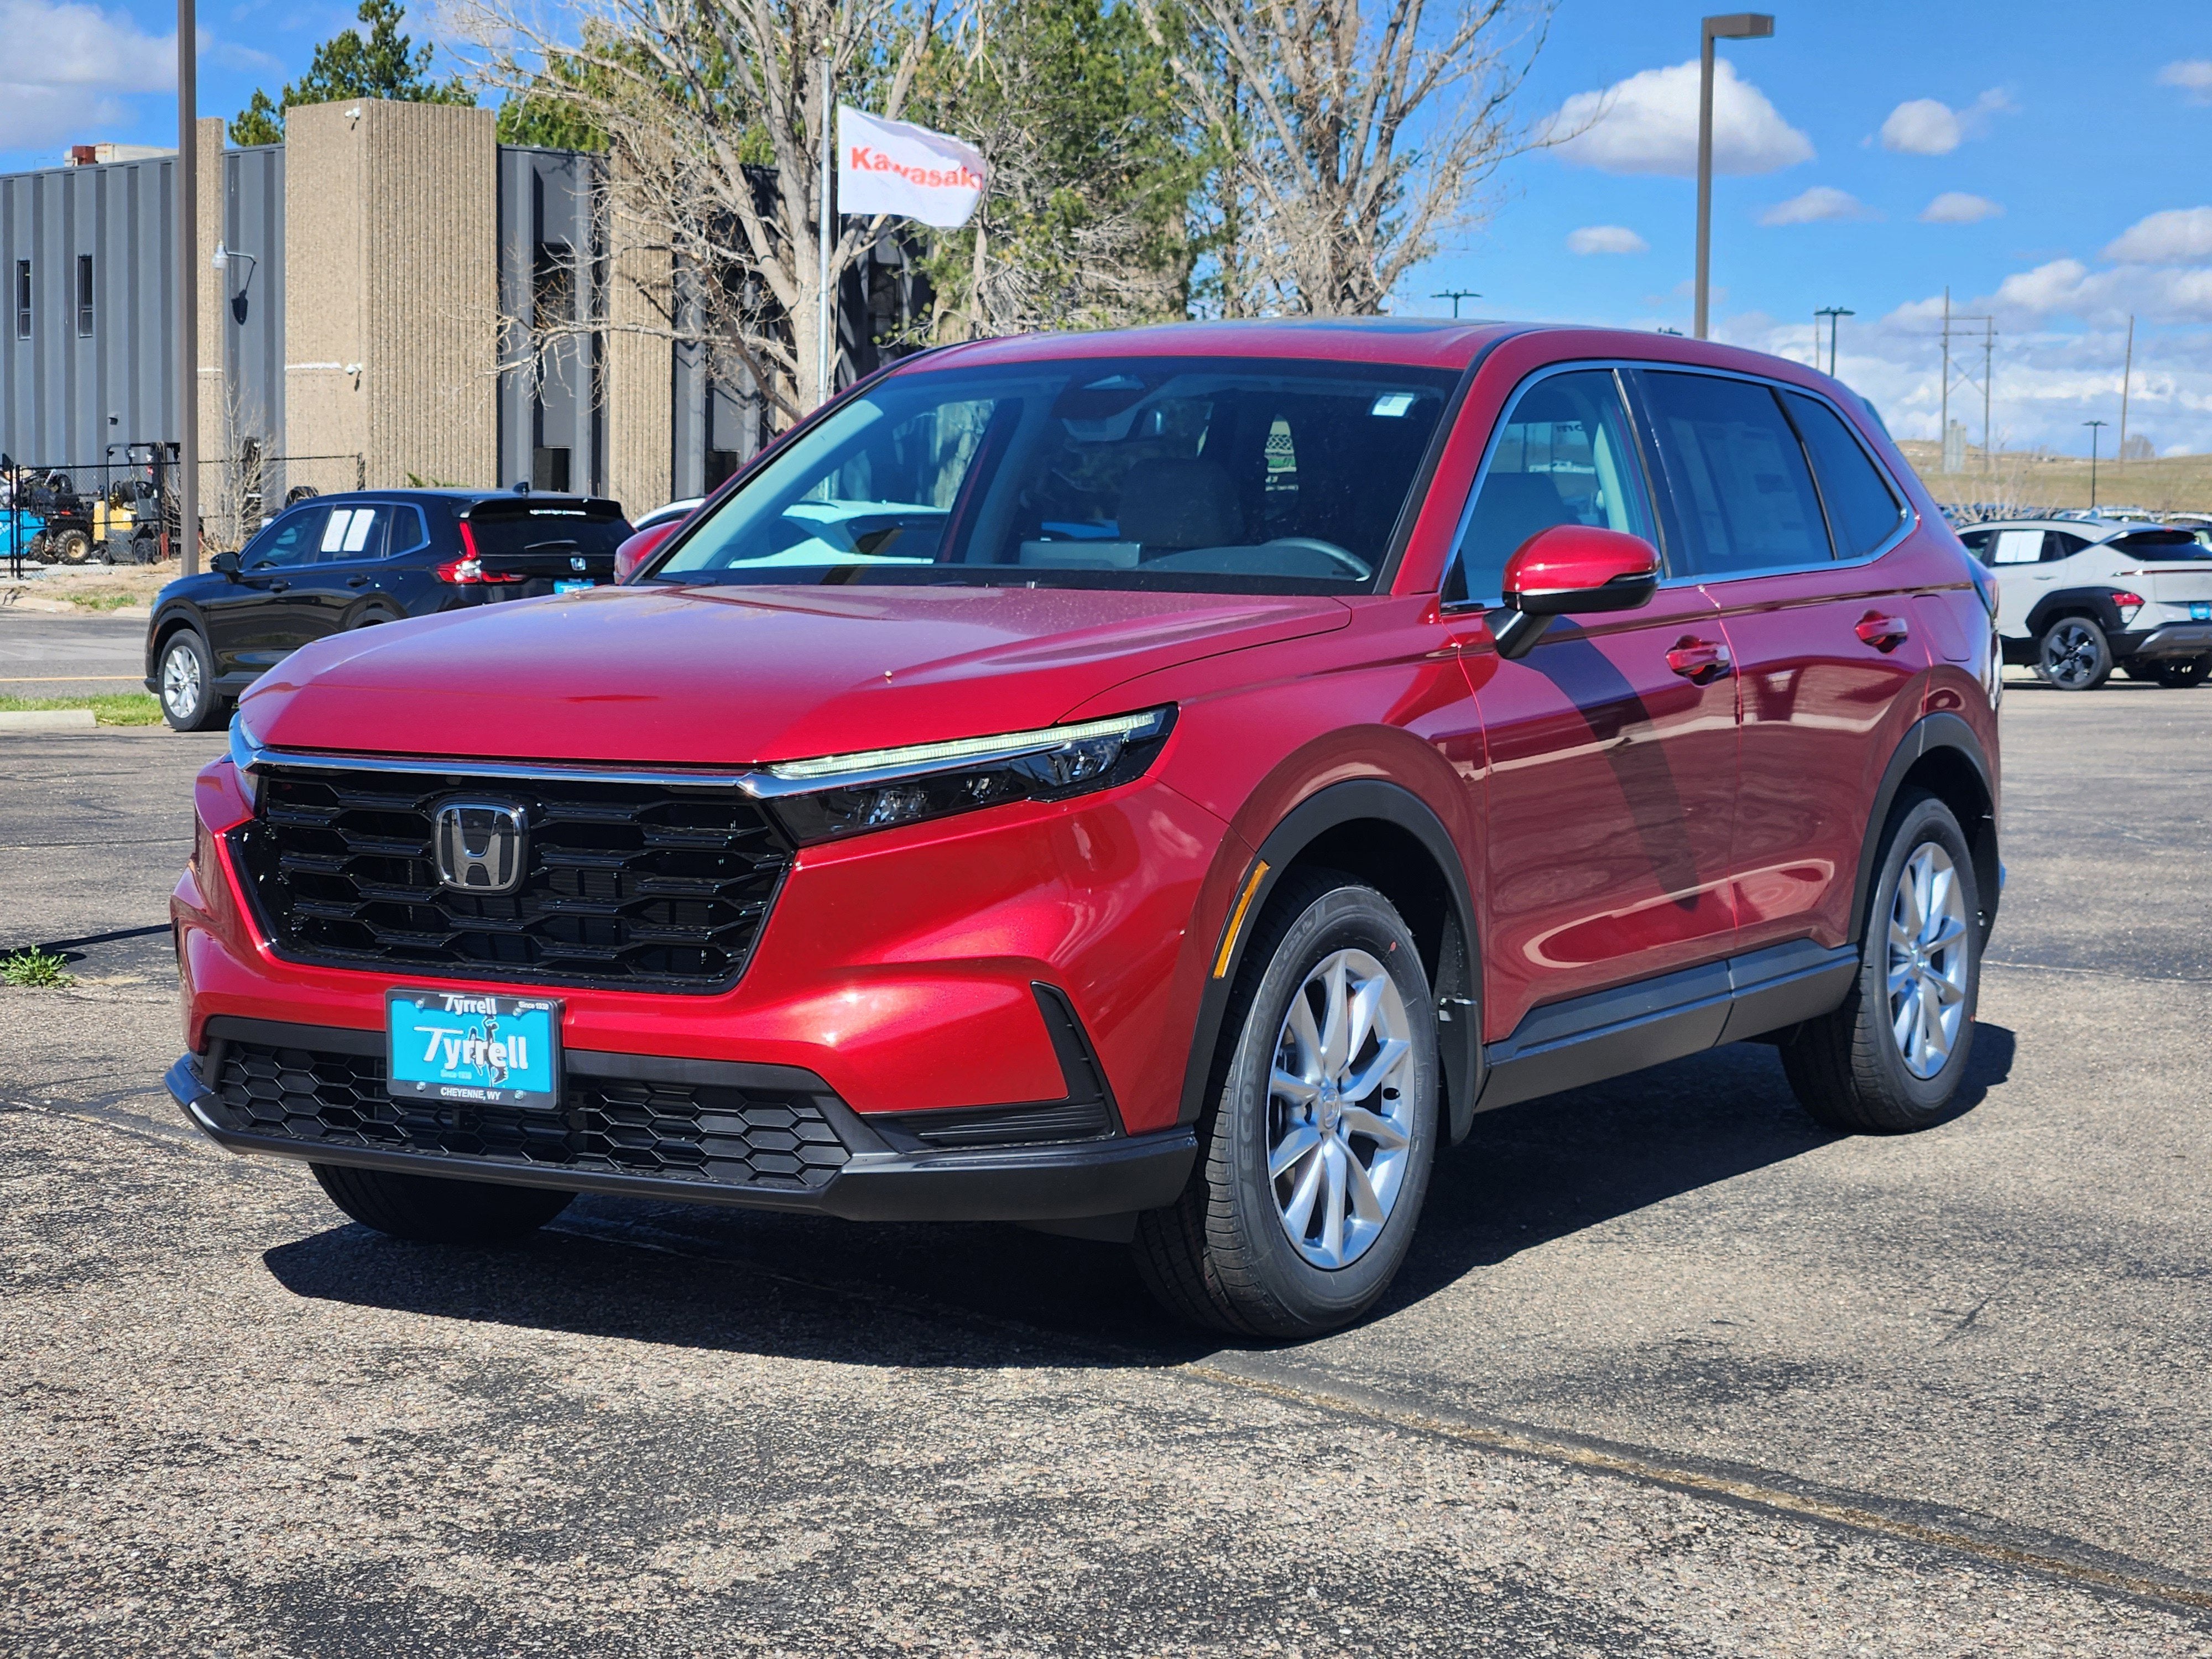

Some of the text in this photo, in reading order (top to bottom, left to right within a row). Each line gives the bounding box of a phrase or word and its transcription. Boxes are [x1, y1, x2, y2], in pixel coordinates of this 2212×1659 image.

[439, 994, 497, 1015] Tyrrell
[414, 1026, 528, 1070] Tyrrell
[440, 1087, 502, 1100] CHEYENNE, WY
